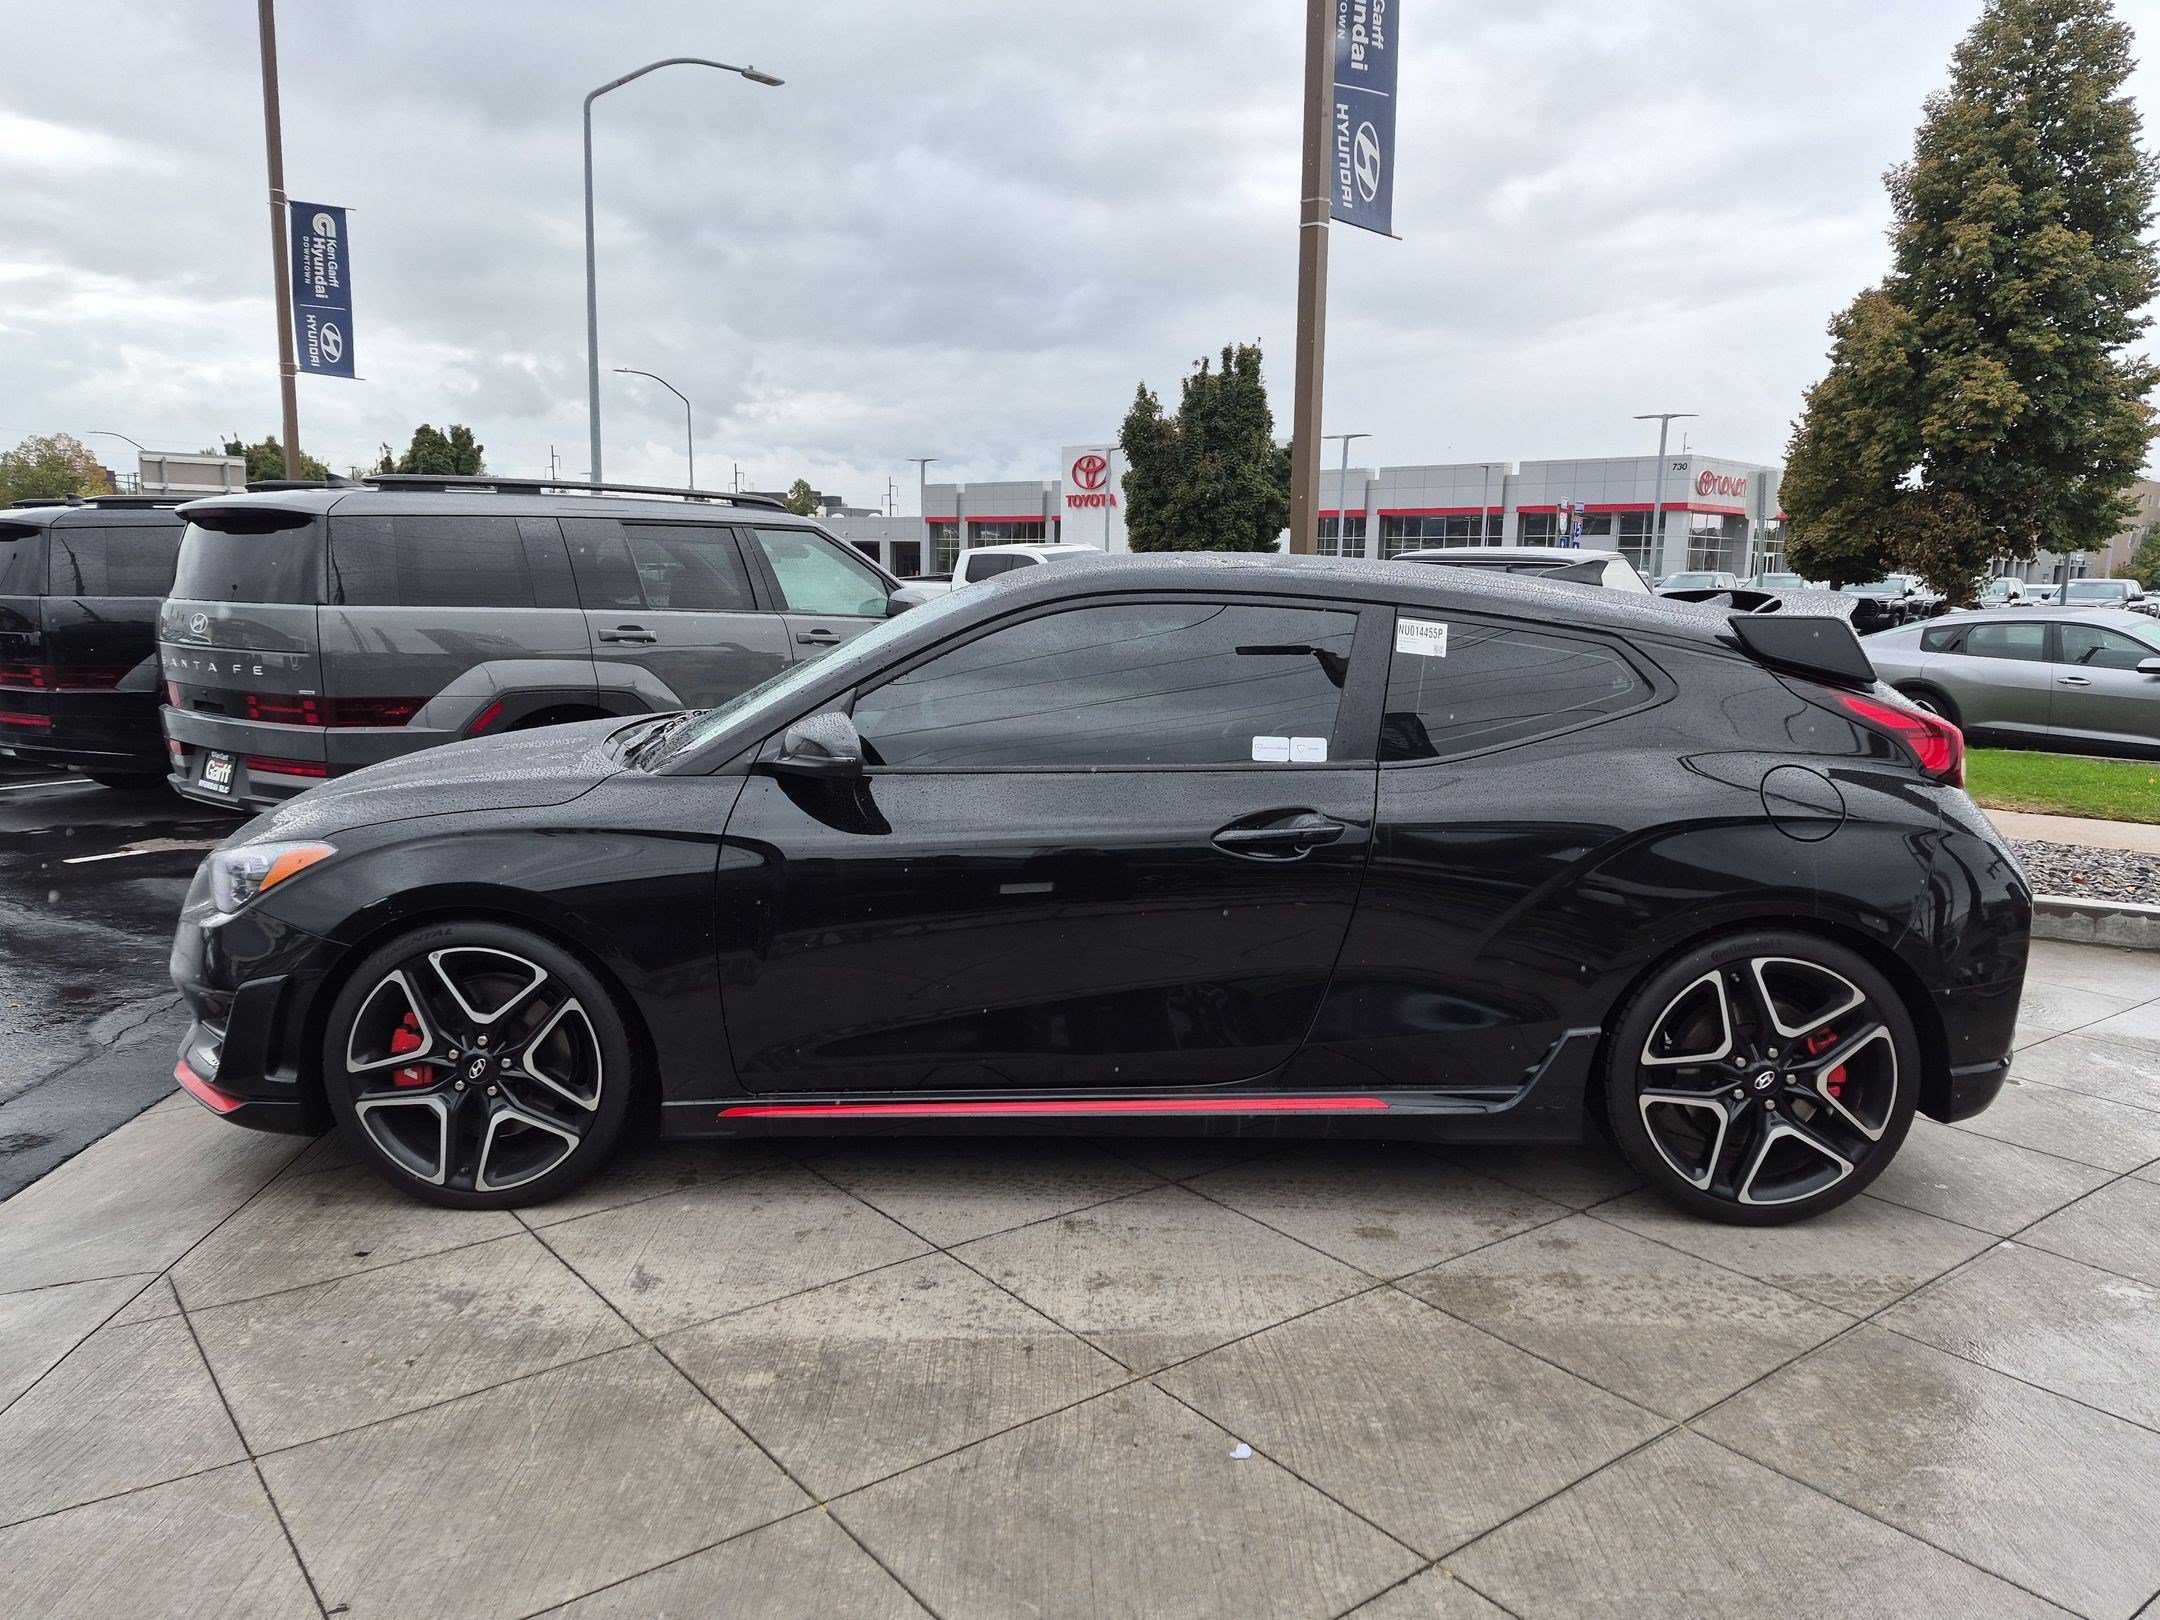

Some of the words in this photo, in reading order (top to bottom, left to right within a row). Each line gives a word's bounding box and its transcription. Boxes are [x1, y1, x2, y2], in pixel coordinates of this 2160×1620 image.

[1337, 0, 1348, 39] OWN
[1351, 0, 1369, 71] ndai
[1336, 103, 1353, 208] HYUNDAI
[302, 235, 312, 284] DOWNTOWN
[326, 239, 338, 260] Ken
[311, 237, 328, 299] Hyundai
[327, 261, 340, 288] Garff
[306, 314, 321, 367] HYUNDAI
[1672, 462, 1688, 471] 730
[1713, 475, 1746, 498] TOYOT
[1065, 494, 1117, 507] TOYOTA
[1399, 623, 1444, 640] NU014455P
[162, 655, 219, 673] SANTA
[233, 664, 264, 676] FE
[206, 759, 232, 784] Garff
